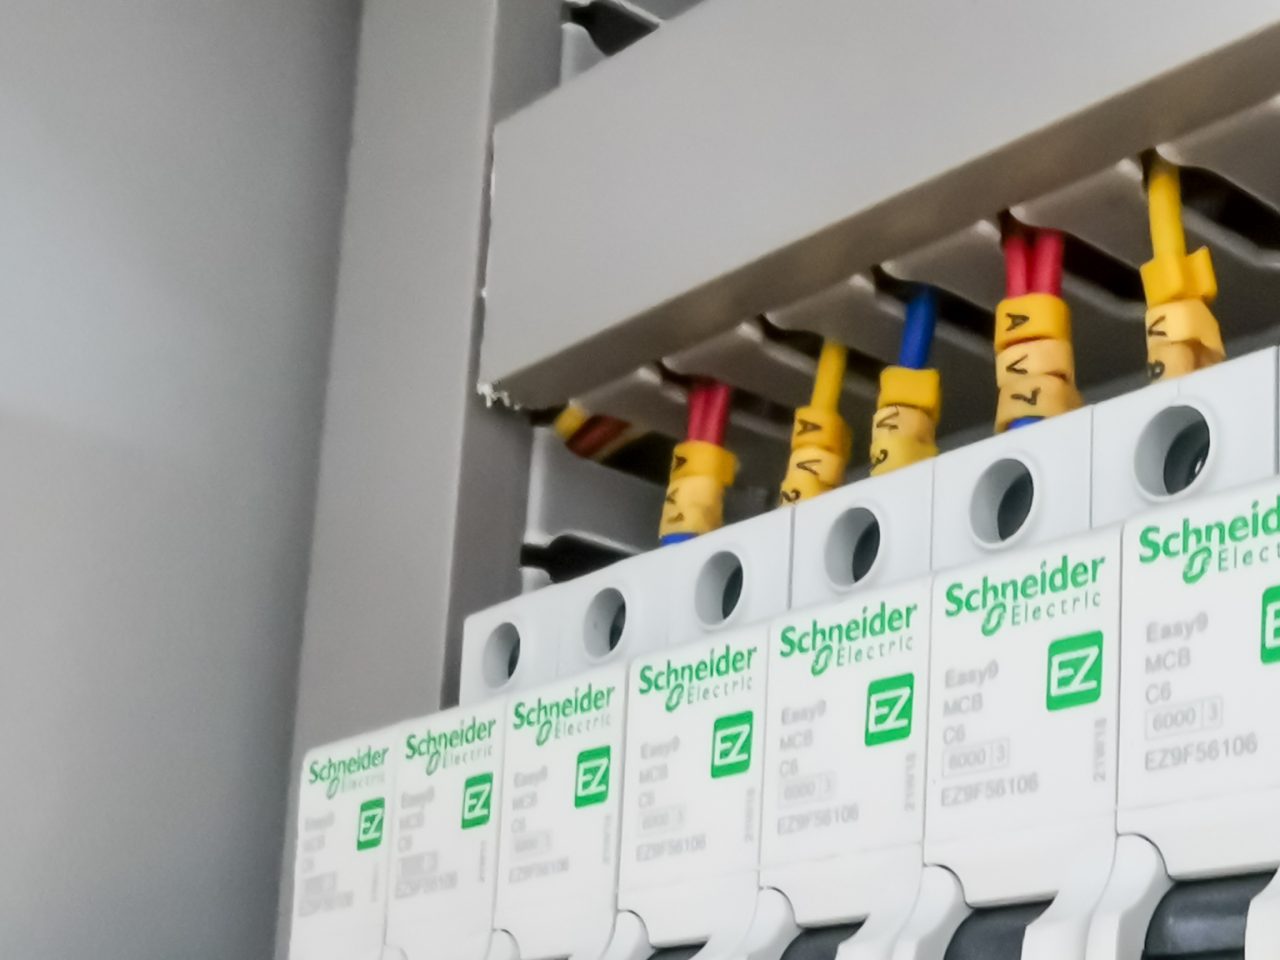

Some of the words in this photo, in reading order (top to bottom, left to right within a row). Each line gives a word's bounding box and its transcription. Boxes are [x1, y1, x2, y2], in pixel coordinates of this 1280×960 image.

[945, 554, 1105, 617] Schneider
[1011, 591, 1101, 626] Electric
[780, 601, 917, 657] Schneider
[639, 644, 757, 695] Schneider
[836, 636, 913, 667] Electric
[1145, 647, 1191, 675] MCB
[513, 683, 615, 730] Schneider
[687, 676, 752, 704] Electric
[943, 693, 983, 717] MCB
[1145, 681, 1172, 705] C6
[405, 717, 496, 760] Schneider
[1152, 709, 1196, 732] 6000
[308, 746, 389, 784] Schneider
[1145, 732, 1258, 771] EZ9F56106
